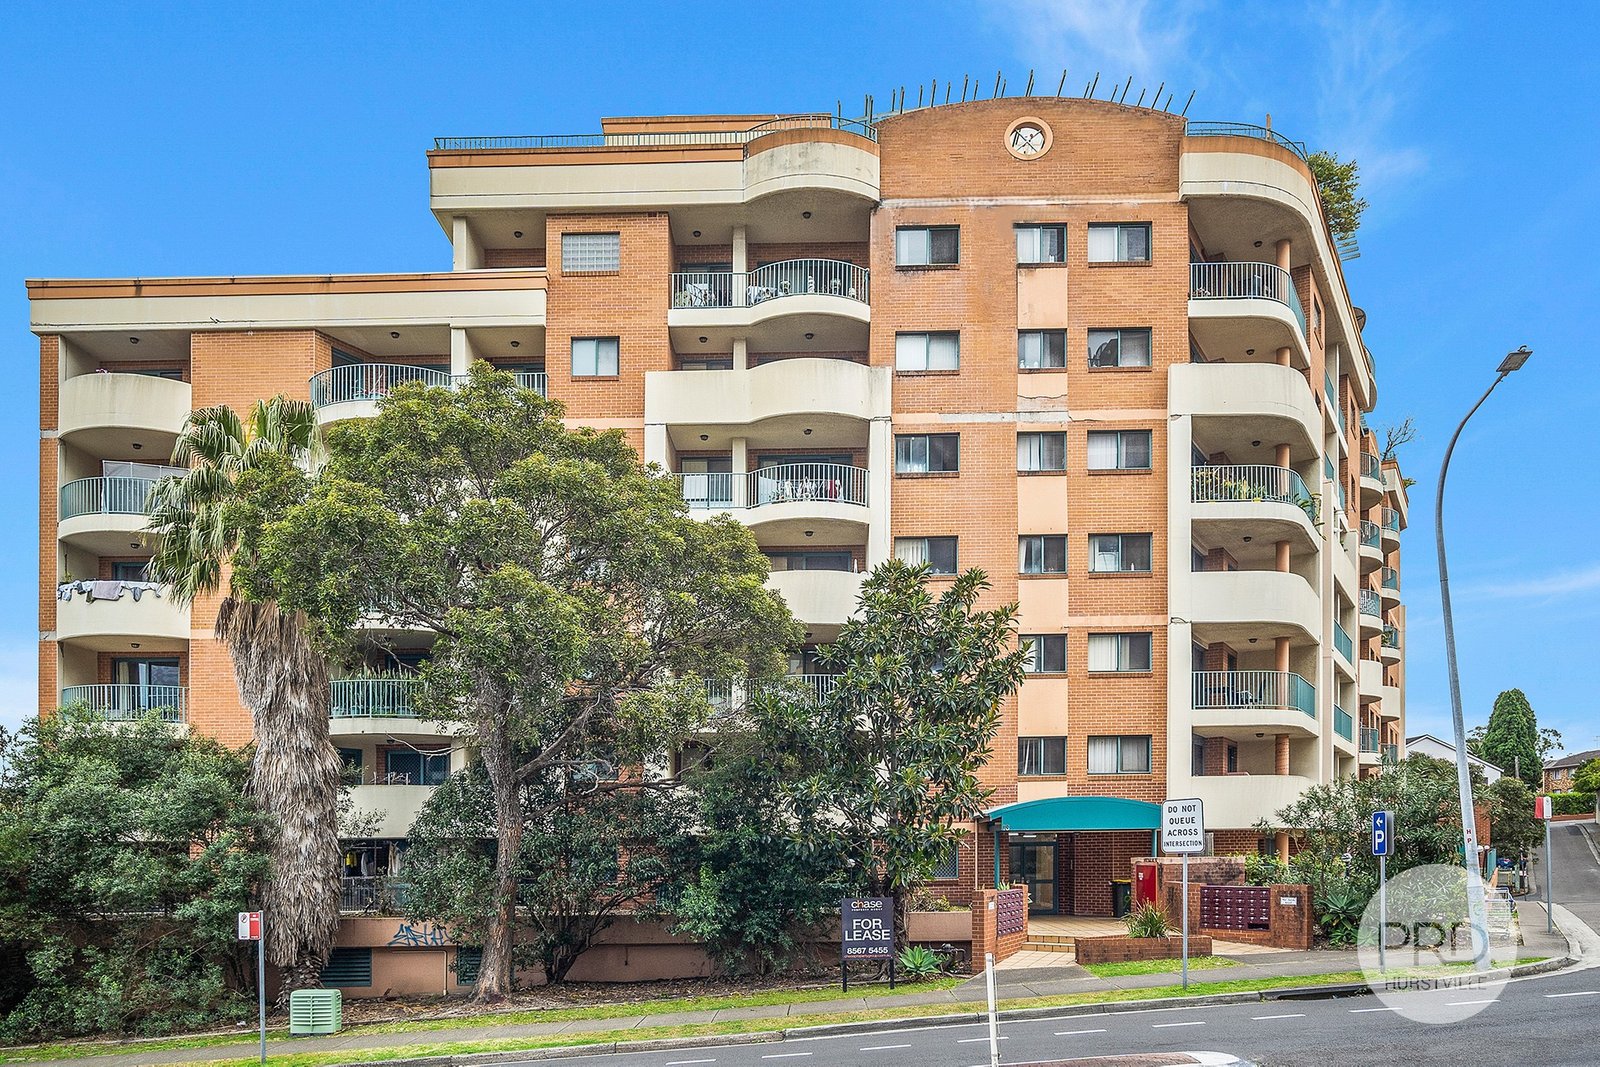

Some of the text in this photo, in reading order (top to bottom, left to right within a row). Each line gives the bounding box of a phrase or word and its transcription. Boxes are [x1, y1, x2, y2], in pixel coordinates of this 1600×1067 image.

[1375, 830, 1385, 850] P
[851, 900, 882, 908] chase
[853, 918, 882, 930] FOR
[845, 929, 890, 940] LEASE
